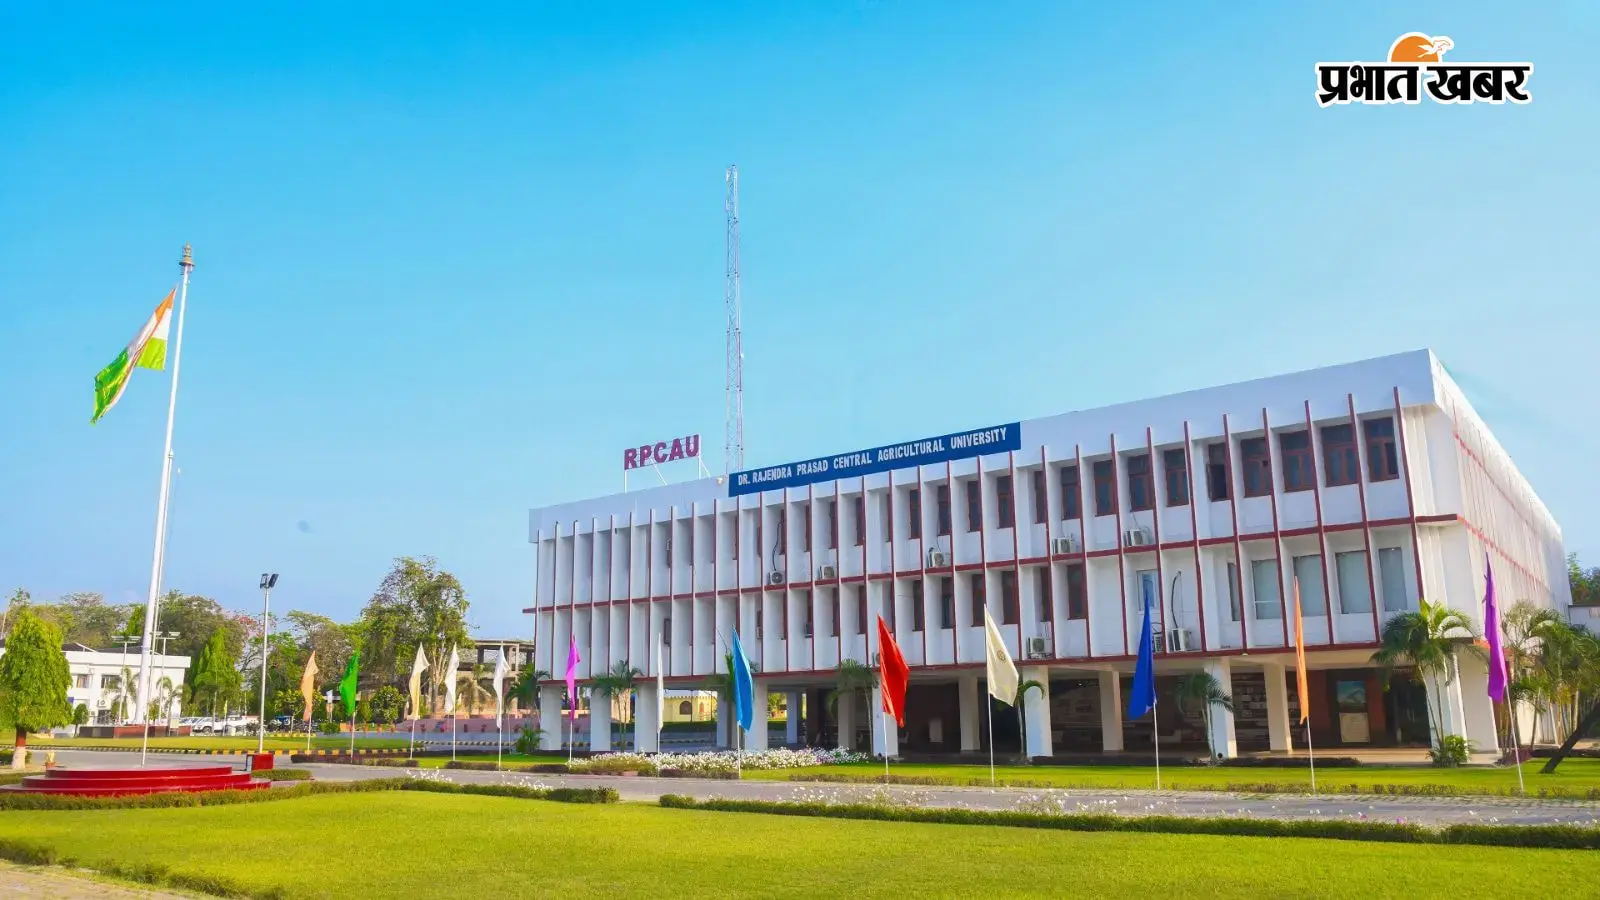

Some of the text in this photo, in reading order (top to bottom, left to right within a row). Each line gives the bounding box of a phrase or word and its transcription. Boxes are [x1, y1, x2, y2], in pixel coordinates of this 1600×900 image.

[624, 434, 699, 470] RPCAU
[738, 427, 1007, 486] DR. RAJENDRA PRASAD CENTRAL AGRICULTURAL UNIVERSITY
